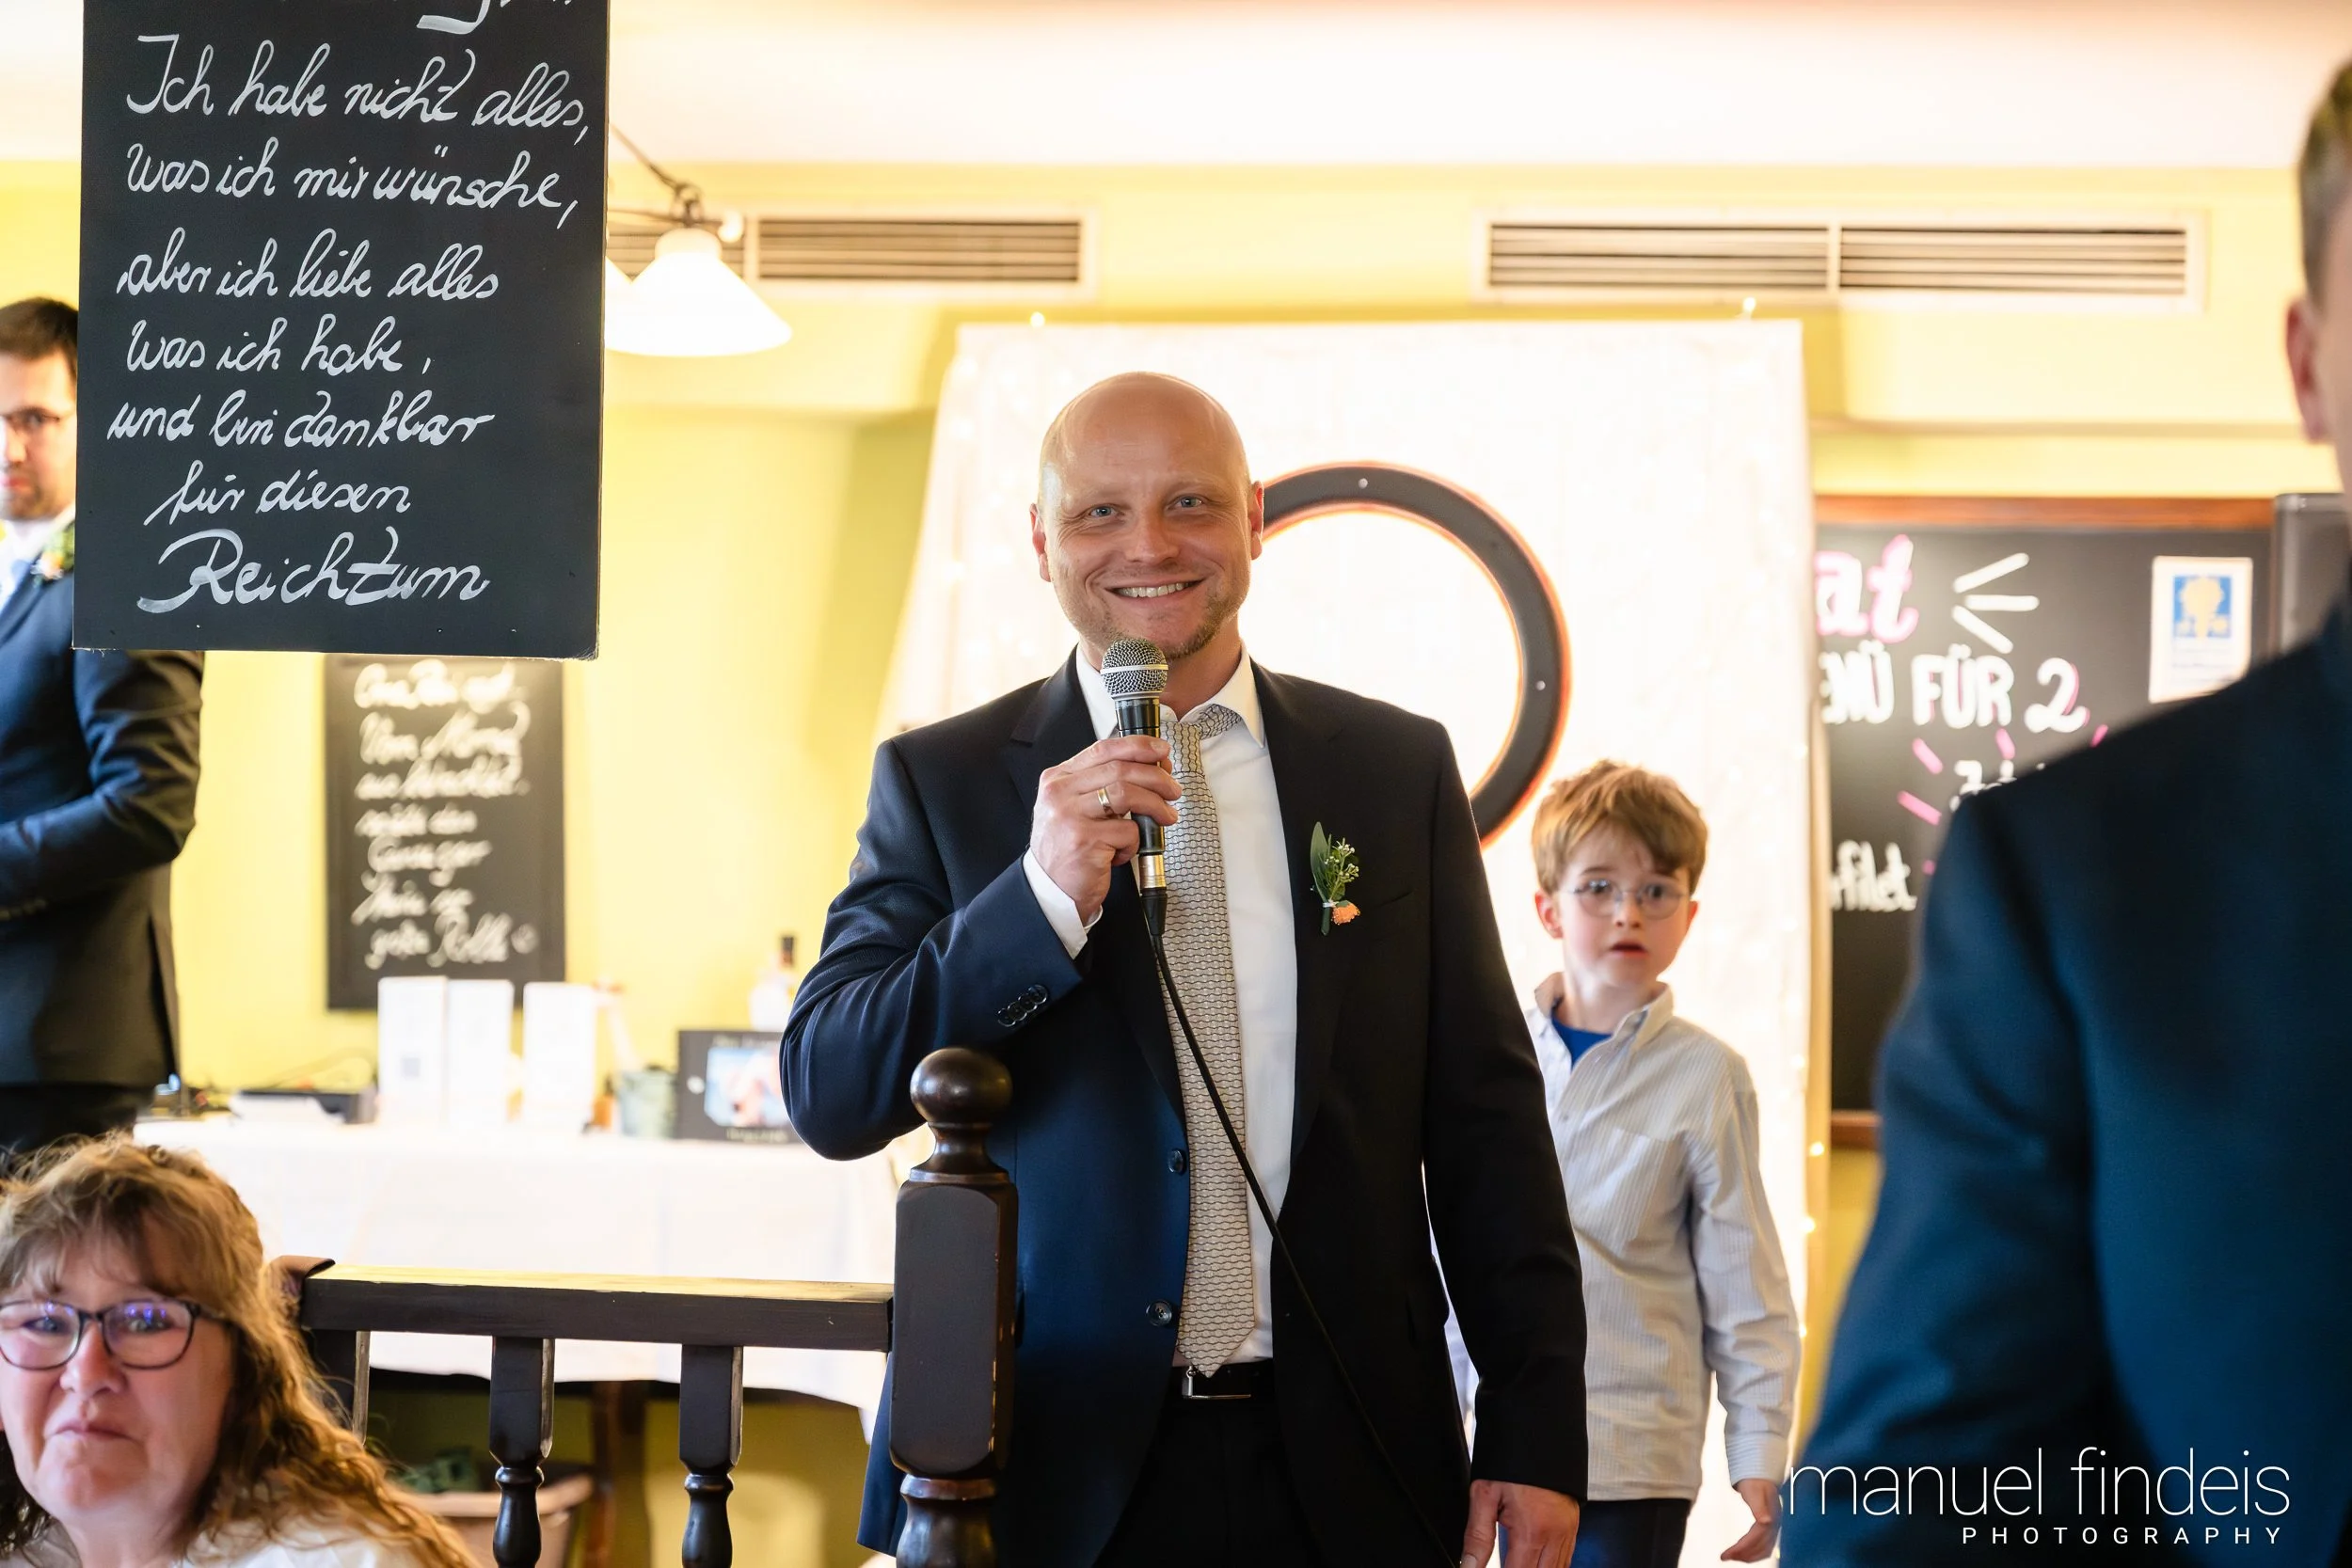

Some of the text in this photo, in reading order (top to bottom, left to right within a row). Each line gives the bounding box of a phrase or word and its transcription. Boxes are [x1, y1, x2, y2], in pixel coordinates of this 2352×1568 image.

[127, 34, 589, 146] Ich habe nicht alles,
[215, 137, 279, 198] ich
[294, 156, 370, 200] mir
[372, 145, 579, 230] wünsche,
[117, 228, 500, 301] aber ich liebe alles
[215, 316, 288, 372] ich
[107, 389, 496, 448] und bin dankbar
[144, 460, 411, 527] für diesen
[1912, 643, 2015, 729] FÜR
[2024, 657, 2090, 733] 2
